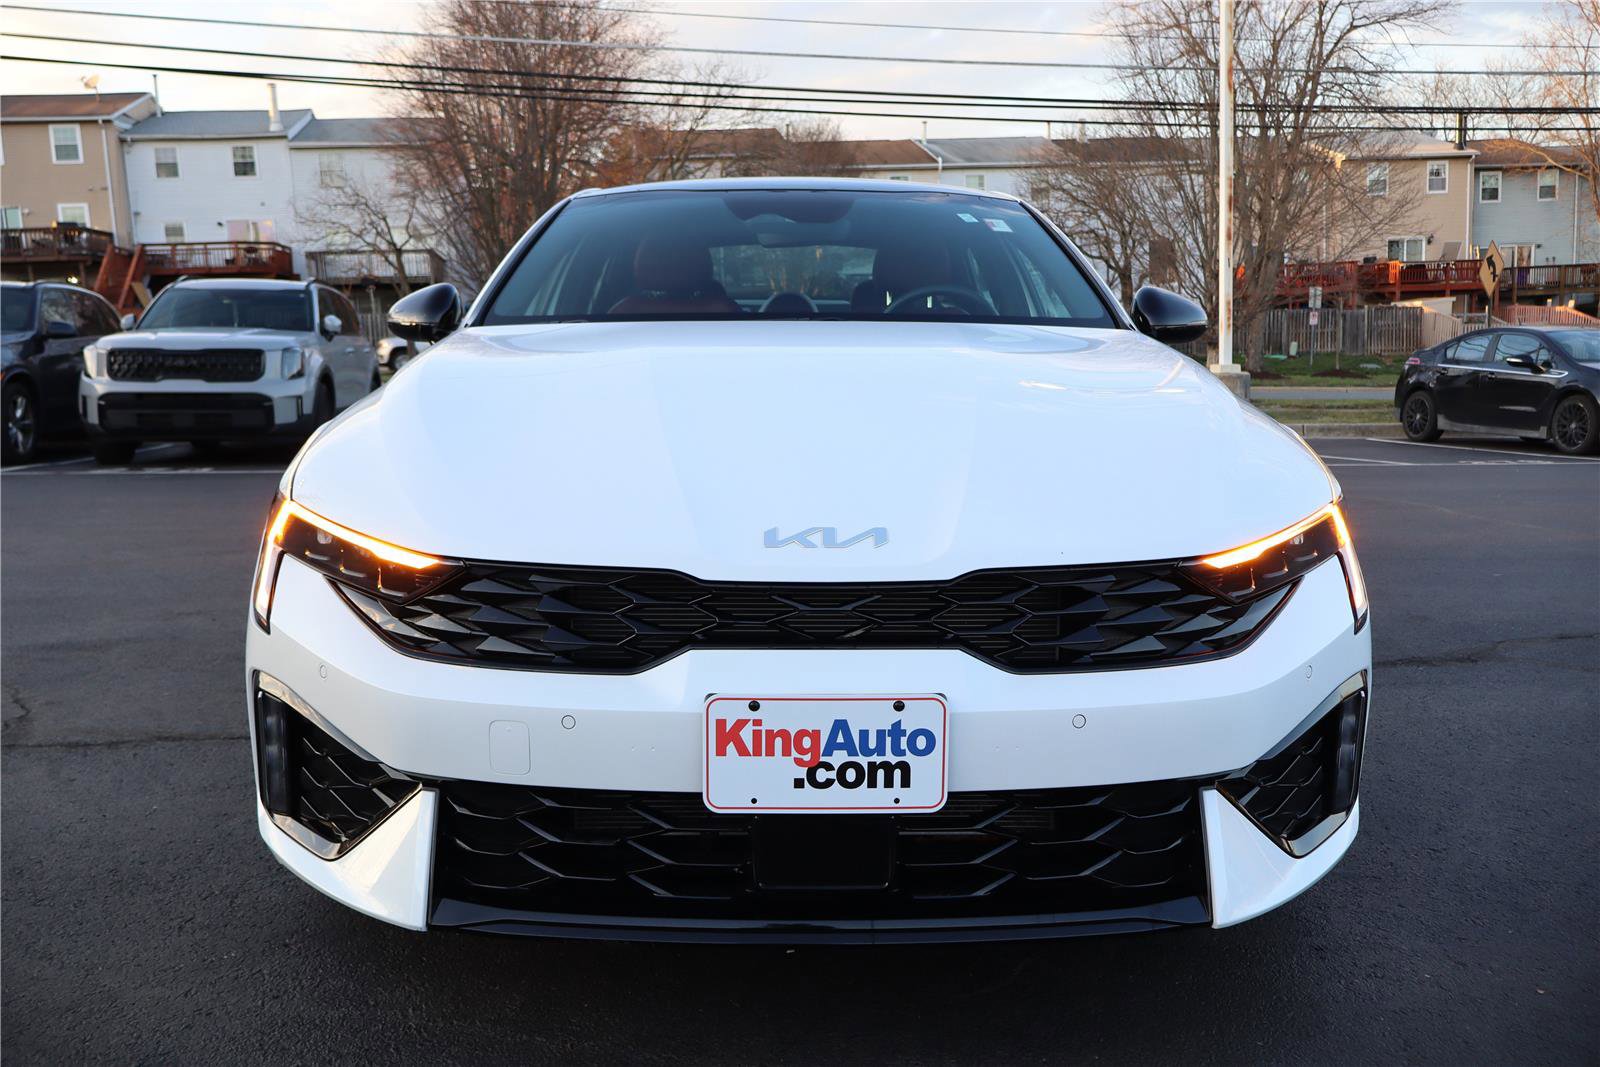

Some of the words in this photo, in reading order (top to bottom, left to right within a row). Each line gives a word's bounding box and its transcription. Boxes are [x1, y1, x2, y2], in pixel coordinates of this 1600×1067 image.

[764, 526, 889, 548] KIA
[715, 718, 936, 767] KingAuto
[793, 760, 911, 789] .com
